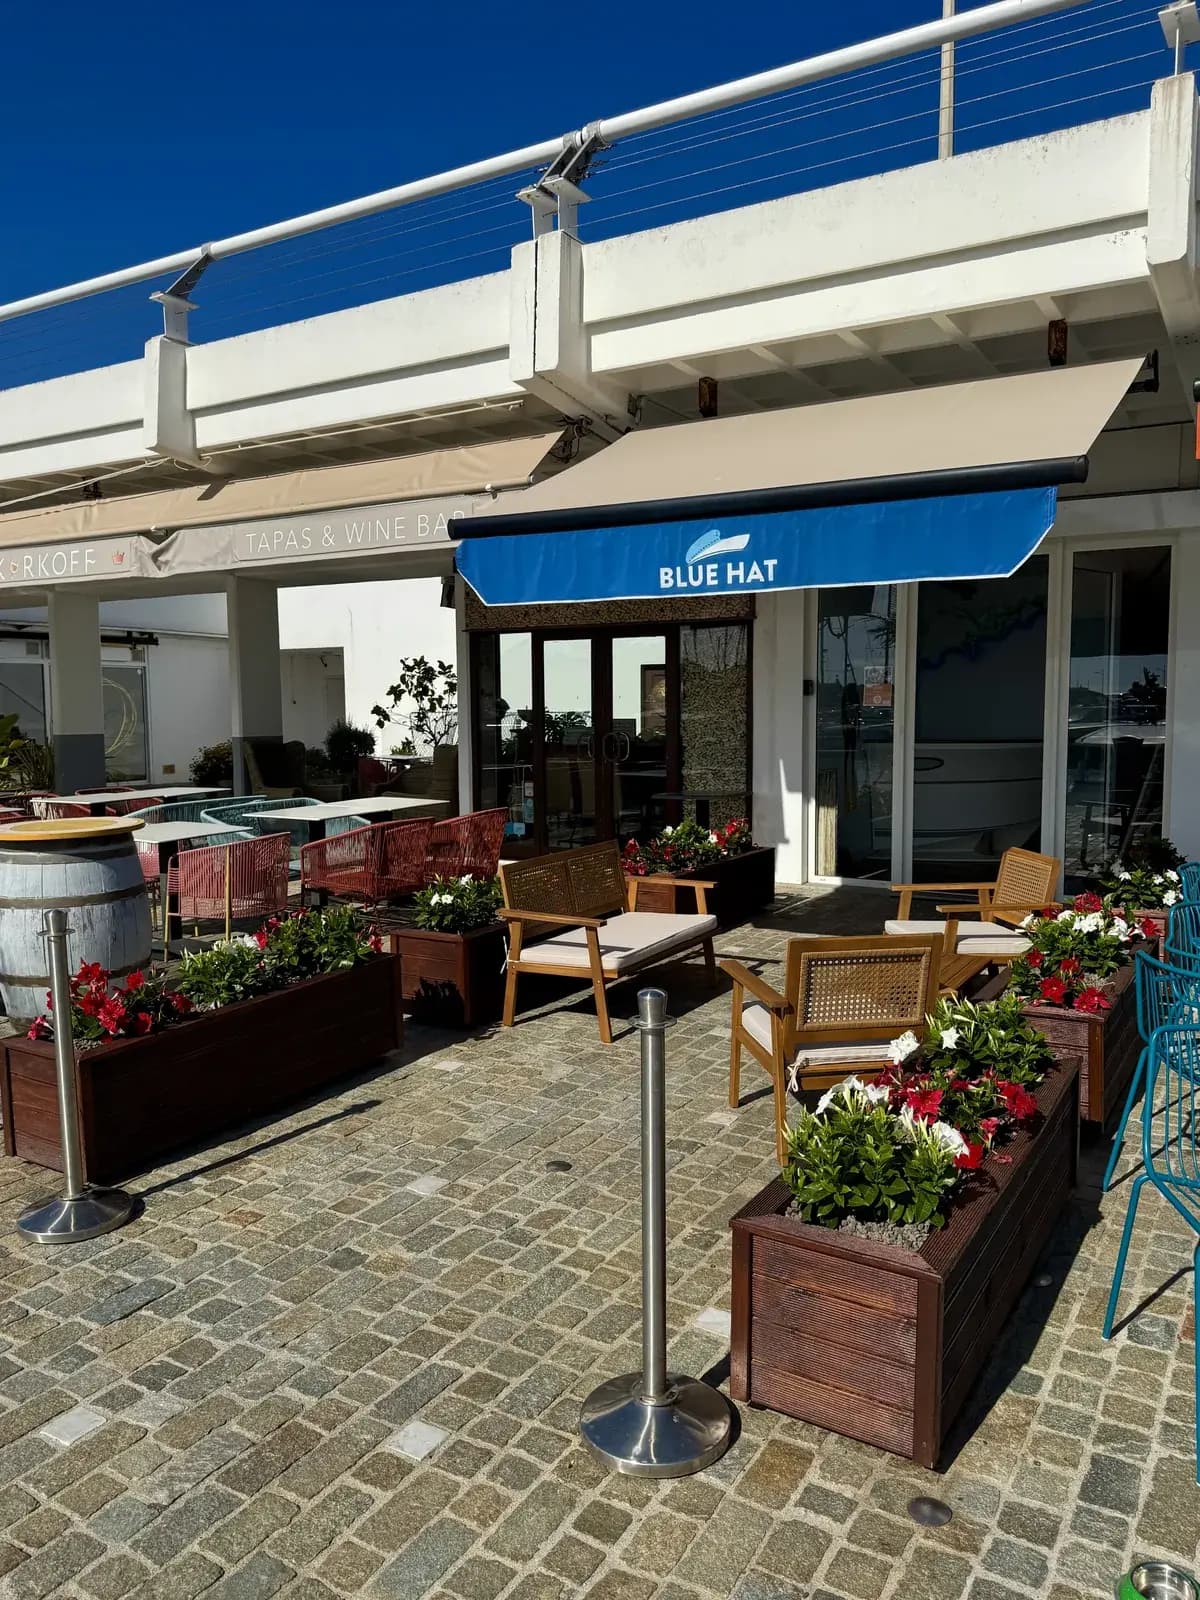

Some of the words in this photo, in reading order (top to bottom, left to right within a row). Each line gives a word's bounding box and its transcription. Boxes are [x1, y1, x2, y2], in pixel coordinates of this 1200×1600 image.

[245, 527, 312, 553] TAPAS
[321, 525, 335, 547] &
[344, 516, 406, 544] WINE
[659, 563, 719, 589] BLUE
[726, 559, 778, 585] HAT
